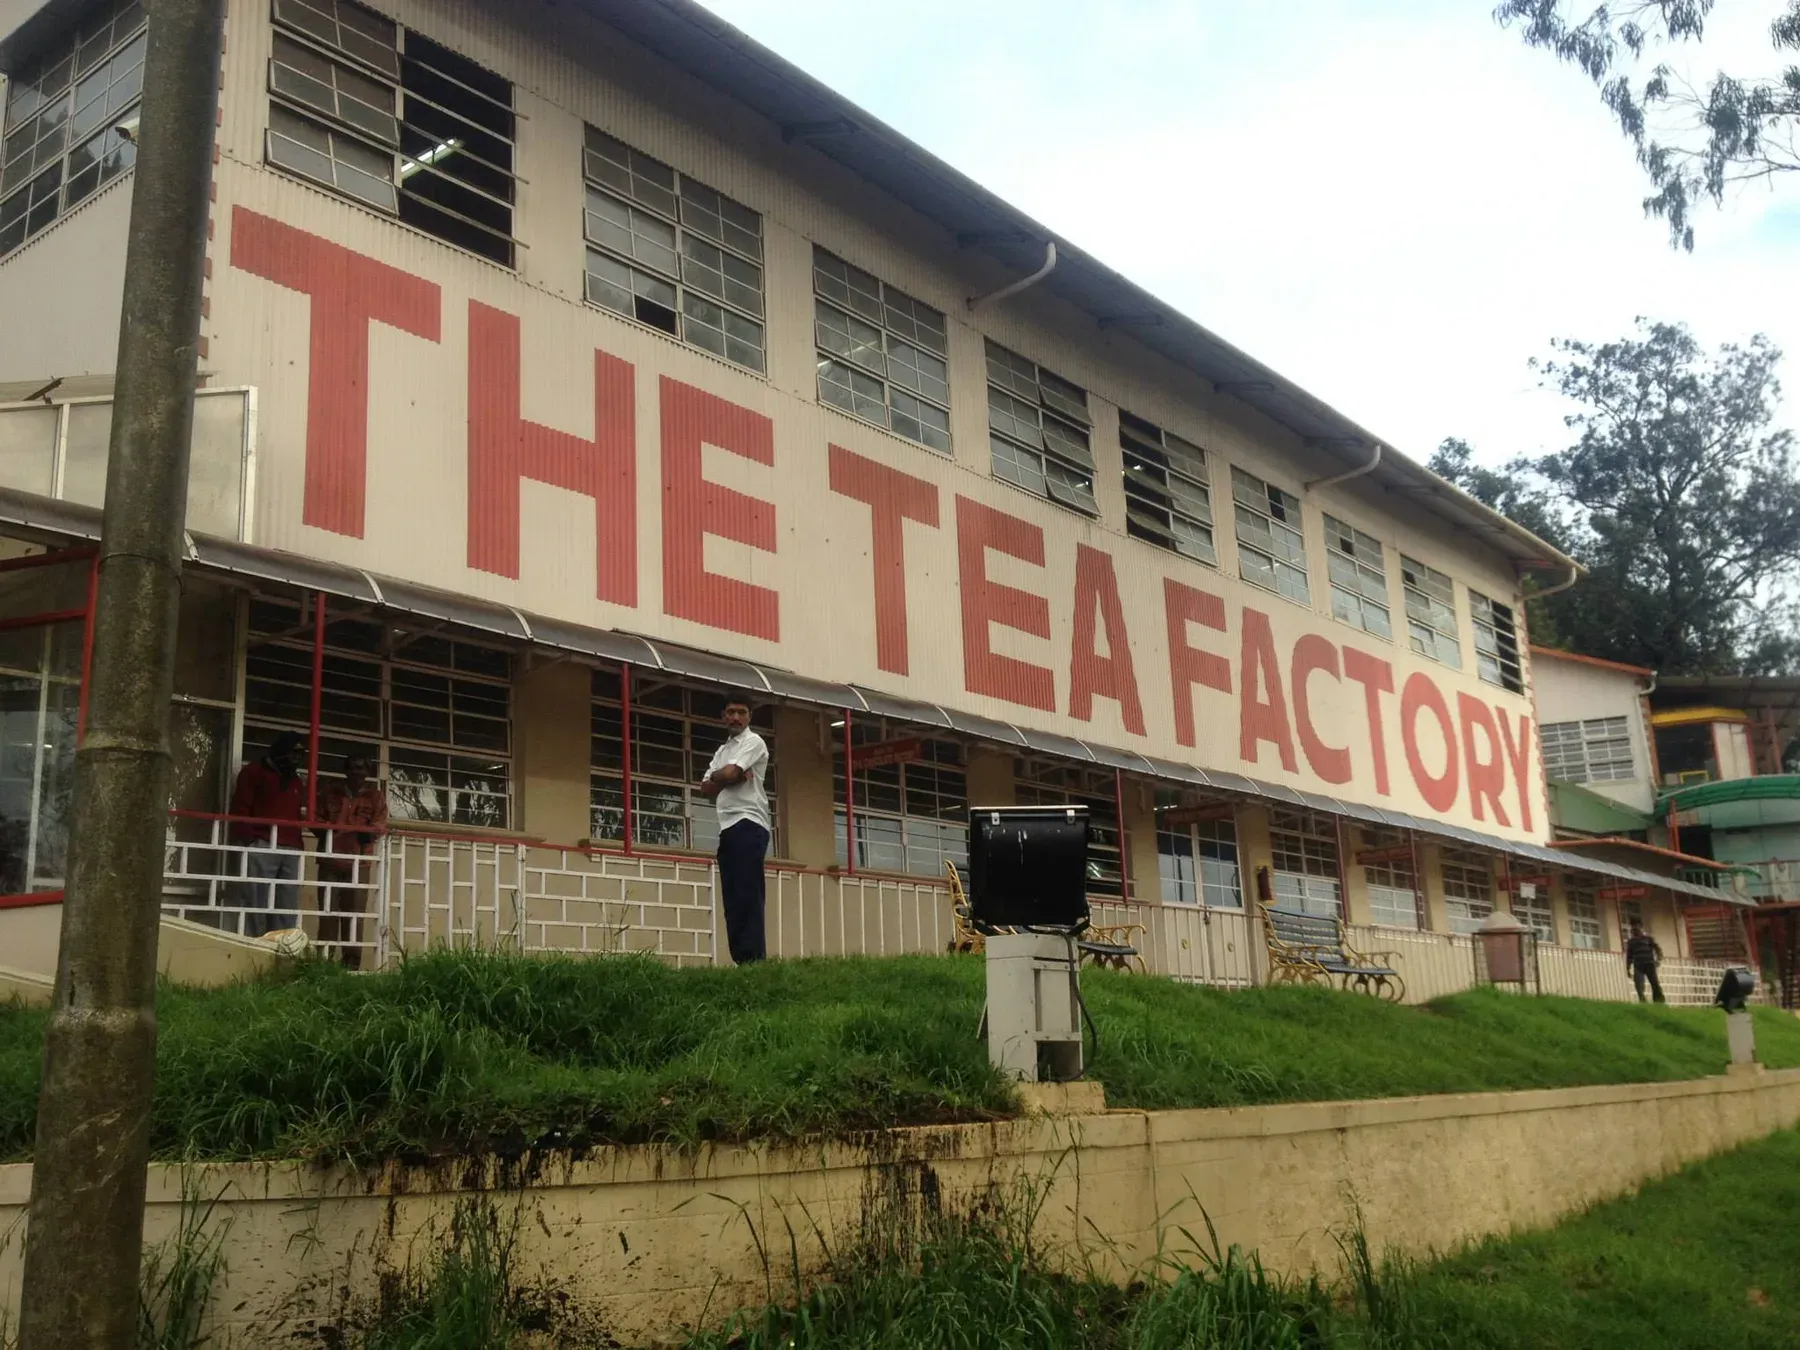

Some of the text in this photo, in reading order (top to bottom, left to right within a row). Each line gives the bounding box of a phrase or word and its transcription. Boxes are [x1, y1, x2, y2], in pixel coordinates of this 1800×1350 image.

[230, 203, 1534, 833] THE TEA FACTORY
